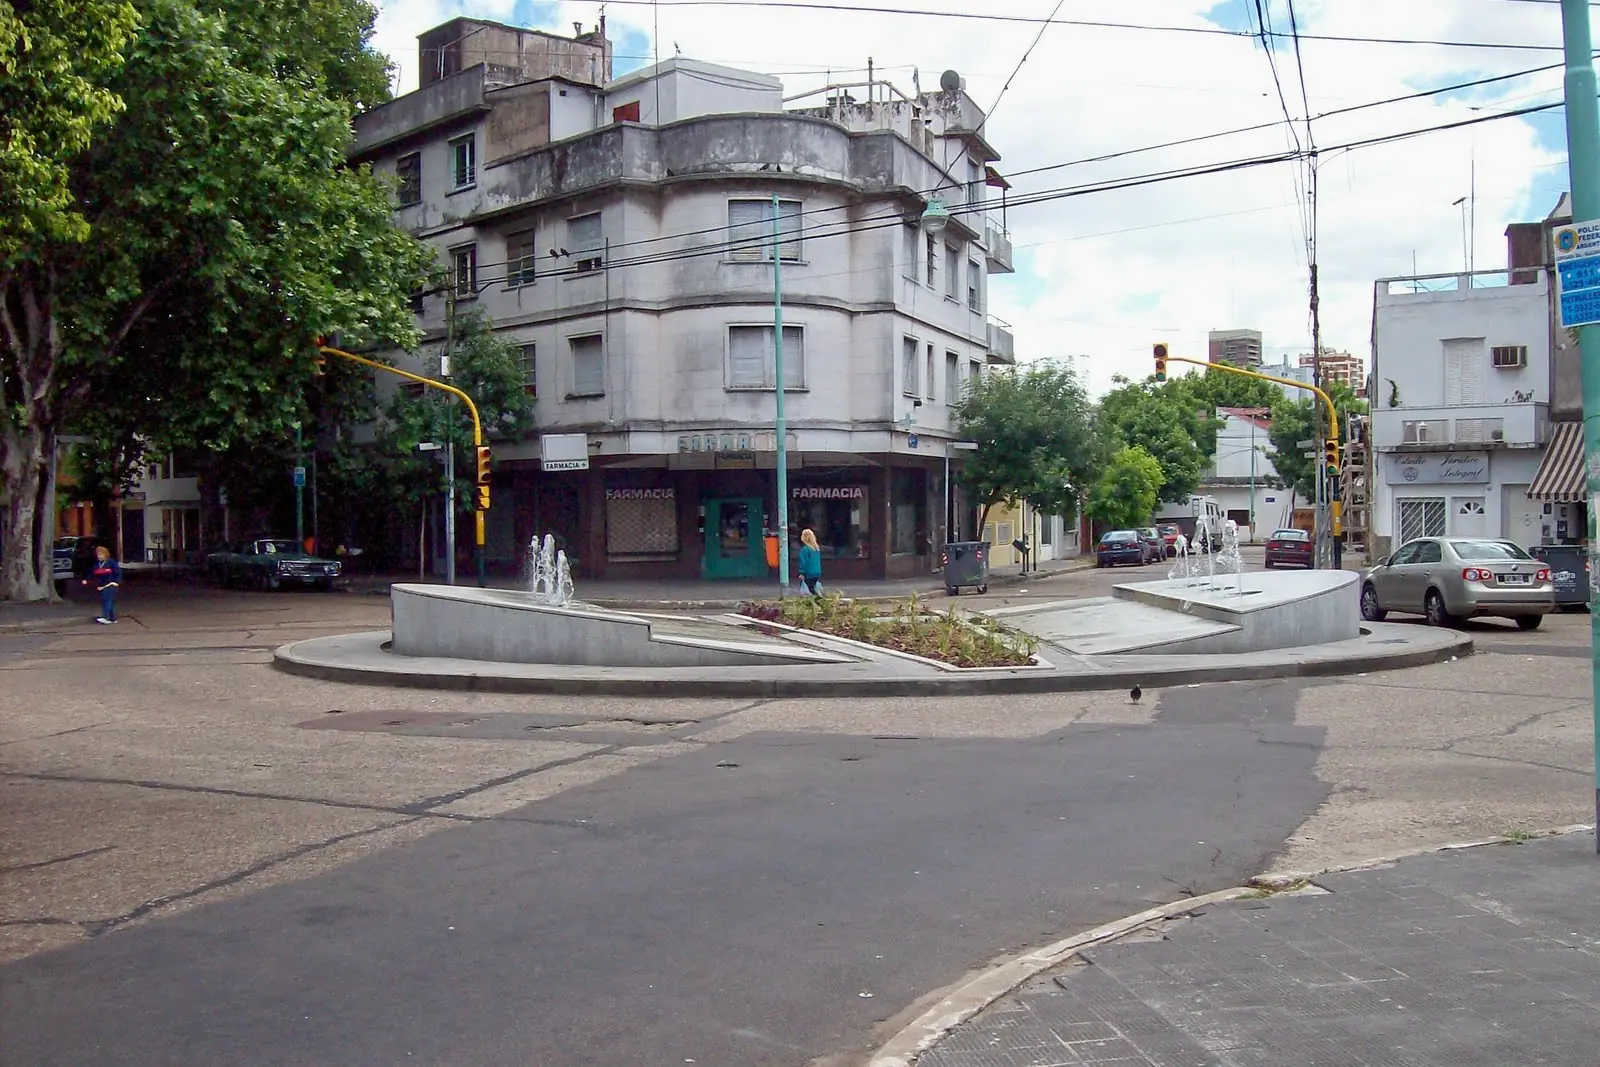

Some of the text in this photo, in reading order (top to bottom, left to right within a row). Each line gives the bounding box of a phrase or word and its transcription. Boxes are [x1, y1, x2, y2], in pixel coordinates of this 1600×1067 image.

[1578, 231, 1600, 241] FEDER
[546, 462, 580, 470] FARMACIA
[1440, 467, 1484, 479] Integral
[606, 488, 674, 499] FARMACIA
[793, 487, 863, 498] FARMACIA
